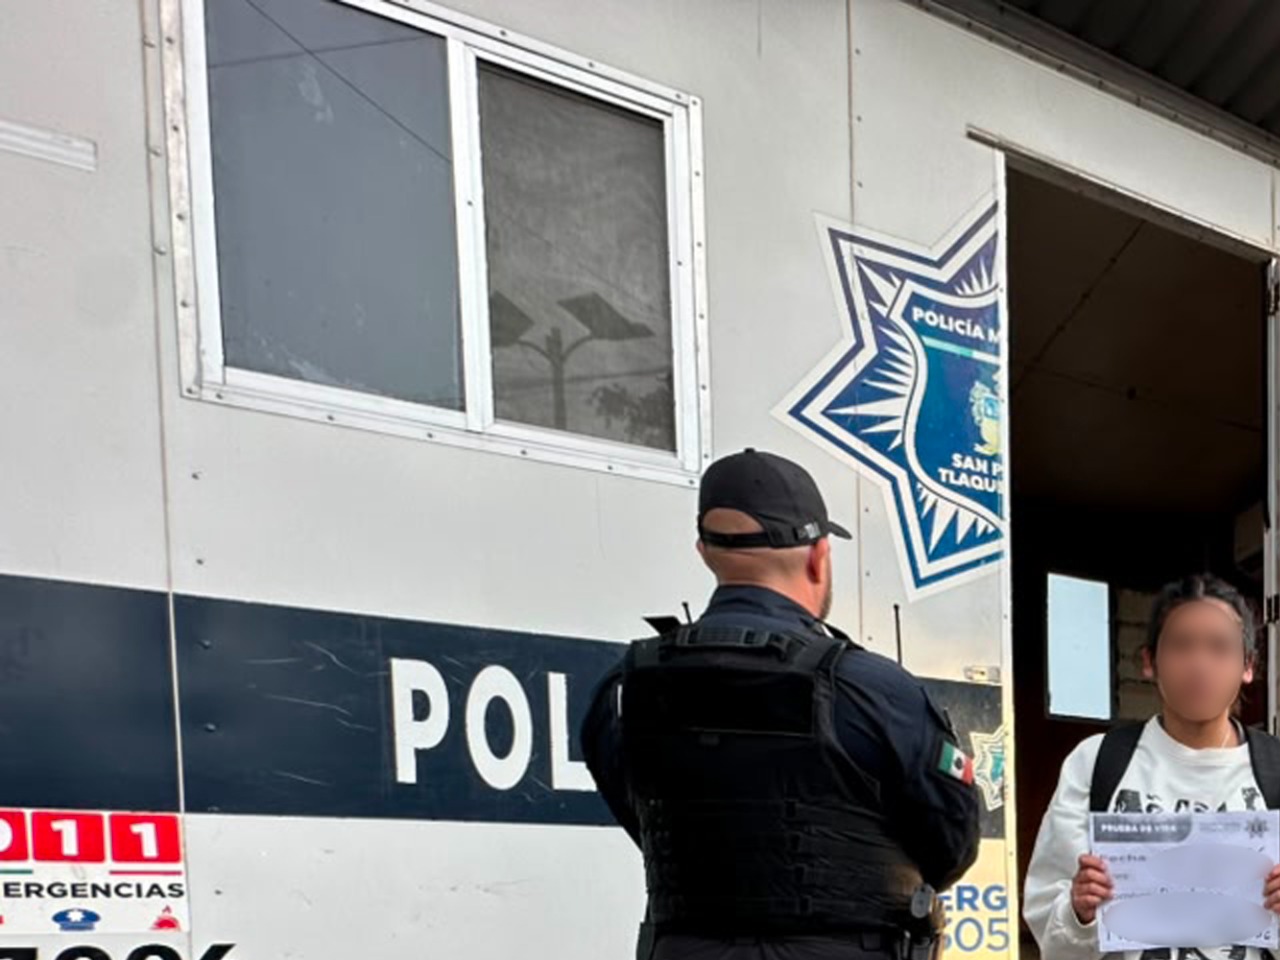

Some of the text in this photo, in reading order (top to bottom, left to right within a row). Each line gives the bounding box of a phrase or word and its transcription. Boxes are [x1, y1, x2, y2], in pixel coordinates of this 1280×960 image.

[912, 306, 985, 340] POLICÍA
[951, 453, 989, 475] SAN
[390, 657, 621, 791] POL
[2, 881, 185, 899] ERGENCIAS
